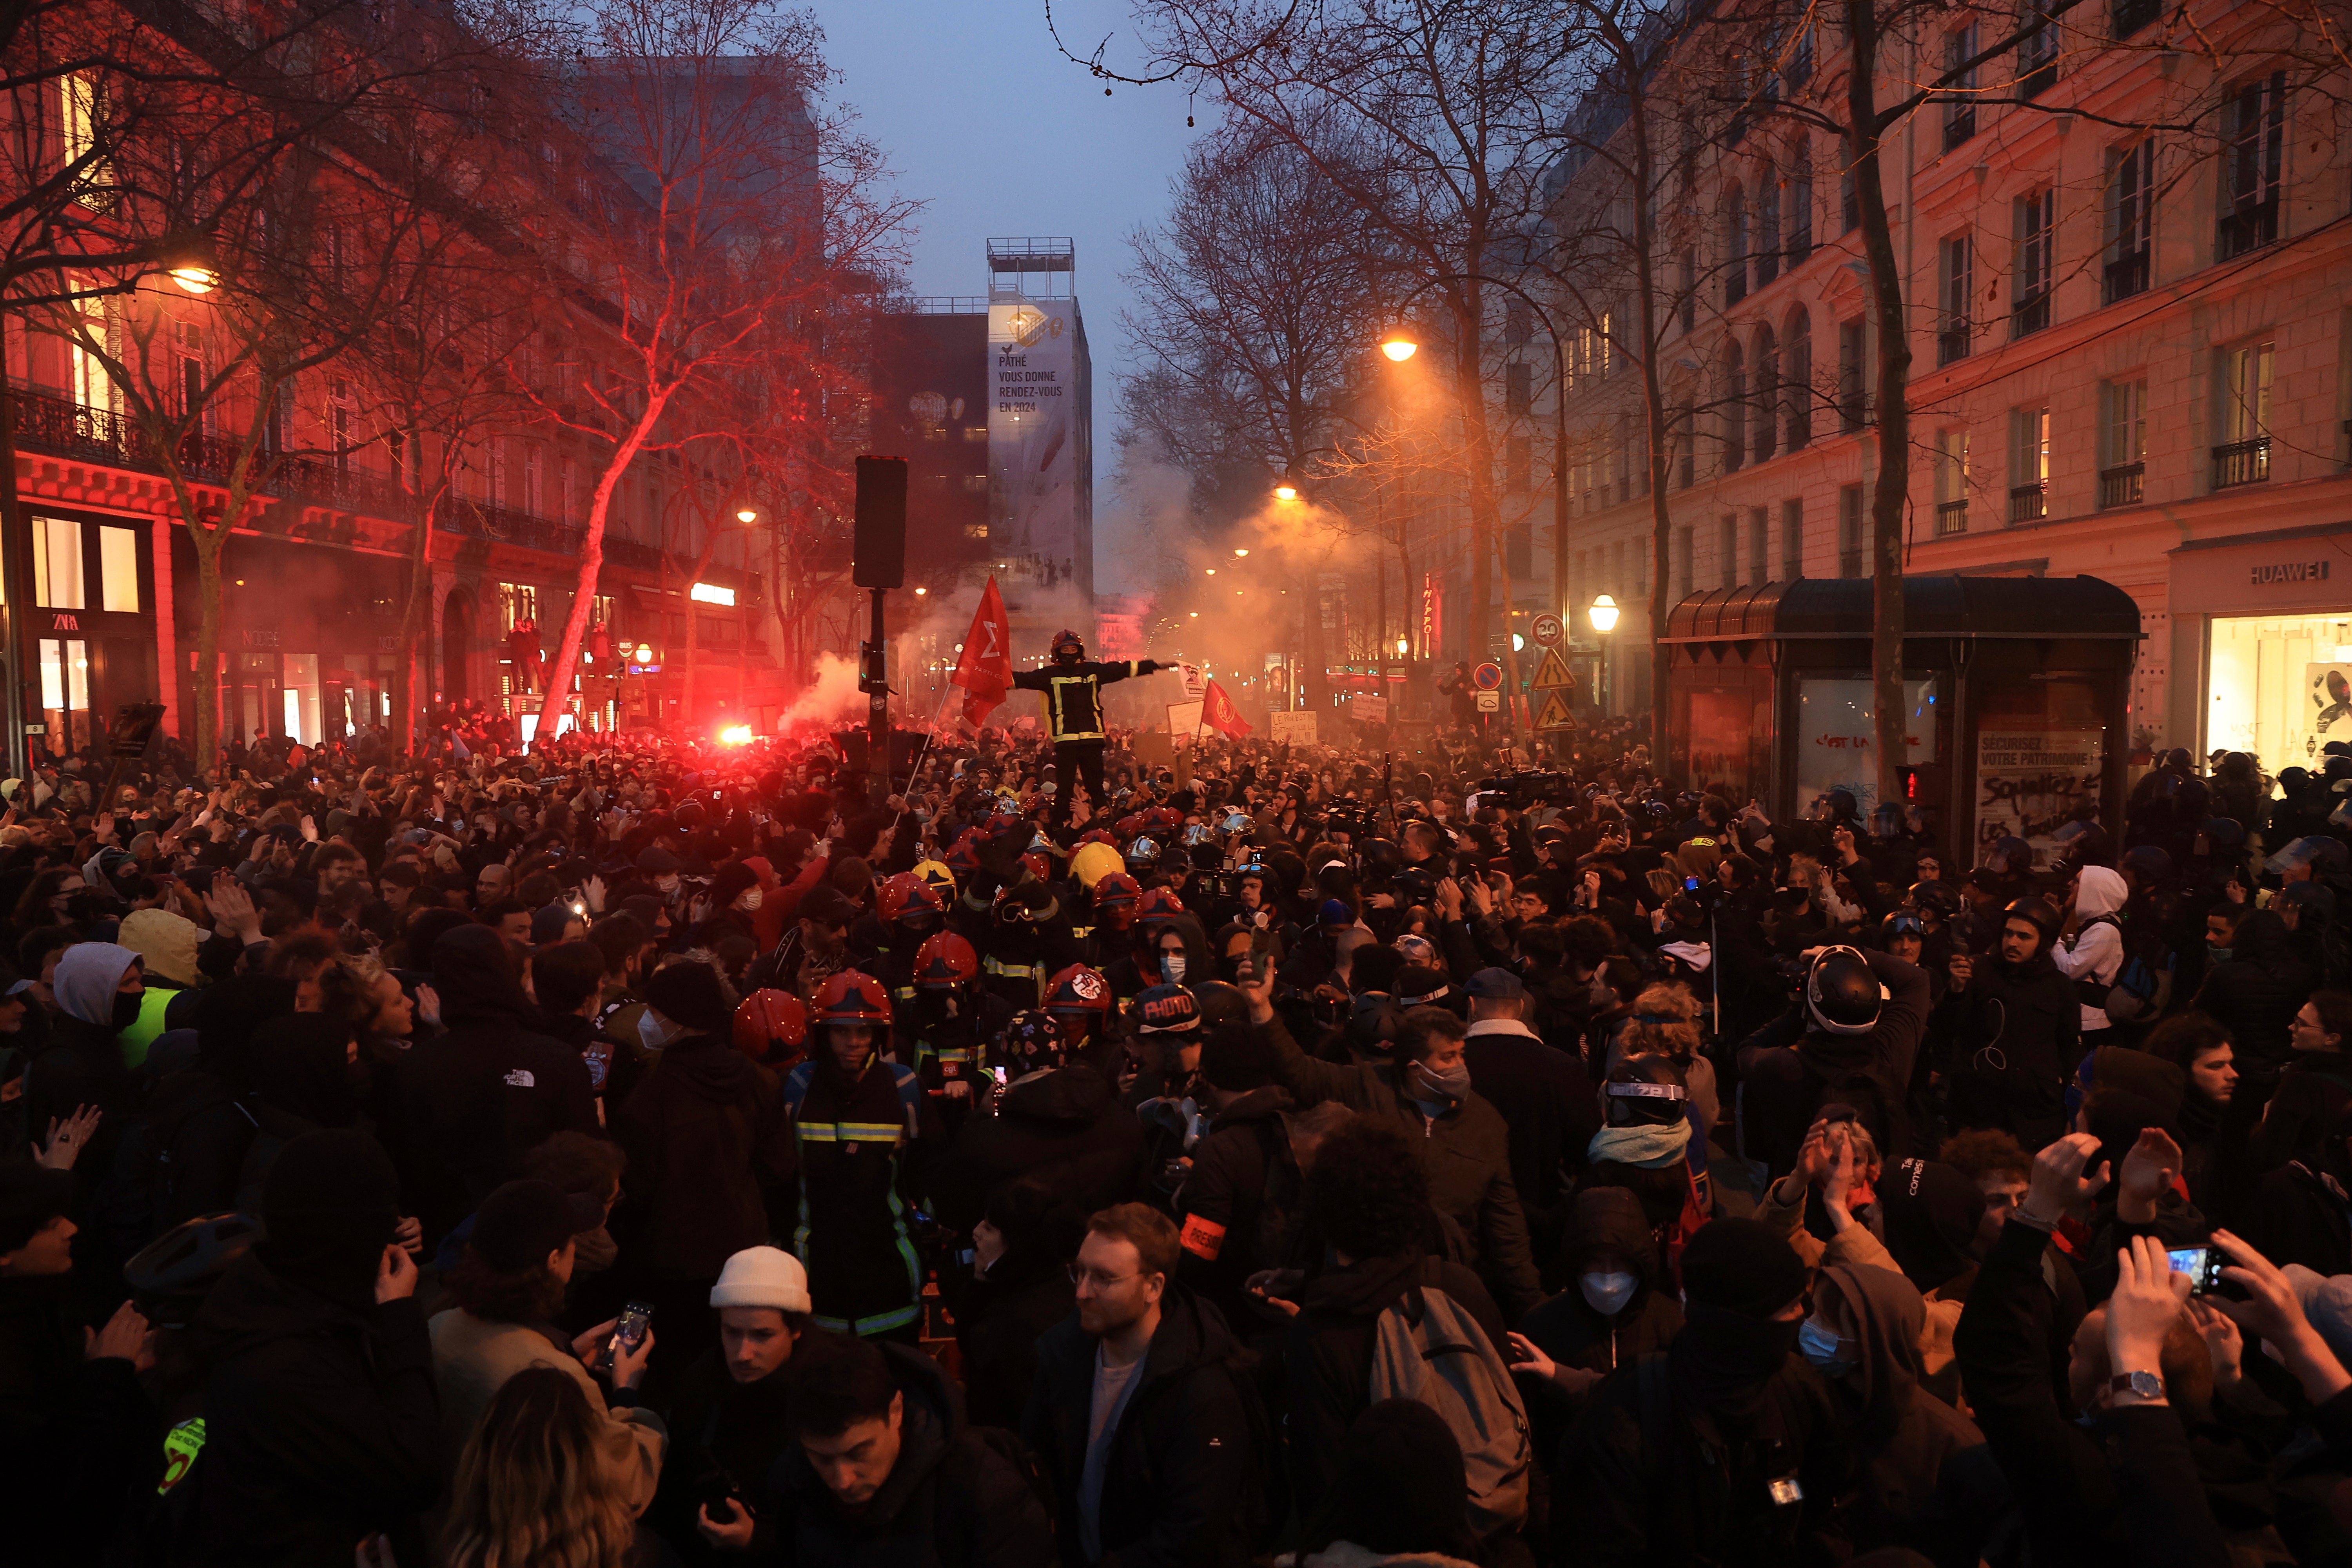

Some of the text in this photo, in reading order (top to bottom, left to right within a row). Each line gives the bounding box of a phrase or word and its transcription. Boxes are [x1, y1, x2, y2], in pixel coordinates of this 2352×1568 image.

[999, 354, 1027, 367] PATHÉ
[999, 371, 1055, 382] VOUS DONNE
[1000, 387, 1062, 397] RENDEZ-VOUS
[1000, 402, 1036, 412] EN 2024
[2249, 561, 2329, 584] HUAWEI
[1423, 590, 1433, 634] HIPPO
[53, 613, 79, 630] ZARA
[1272, 714, 1283, 726] LE
[1982, 734, 2042, 750] SÉCURISEZ
[1981, 752, 2017, 766] VOTRE
[2020, 752, 2088, 766] PATRIMOINE
[1144, 995, 1193, 1020] PHOTO
[944, 1065, 957, 1074] cgt
[1909, 1161, 1924, 1196] comes
